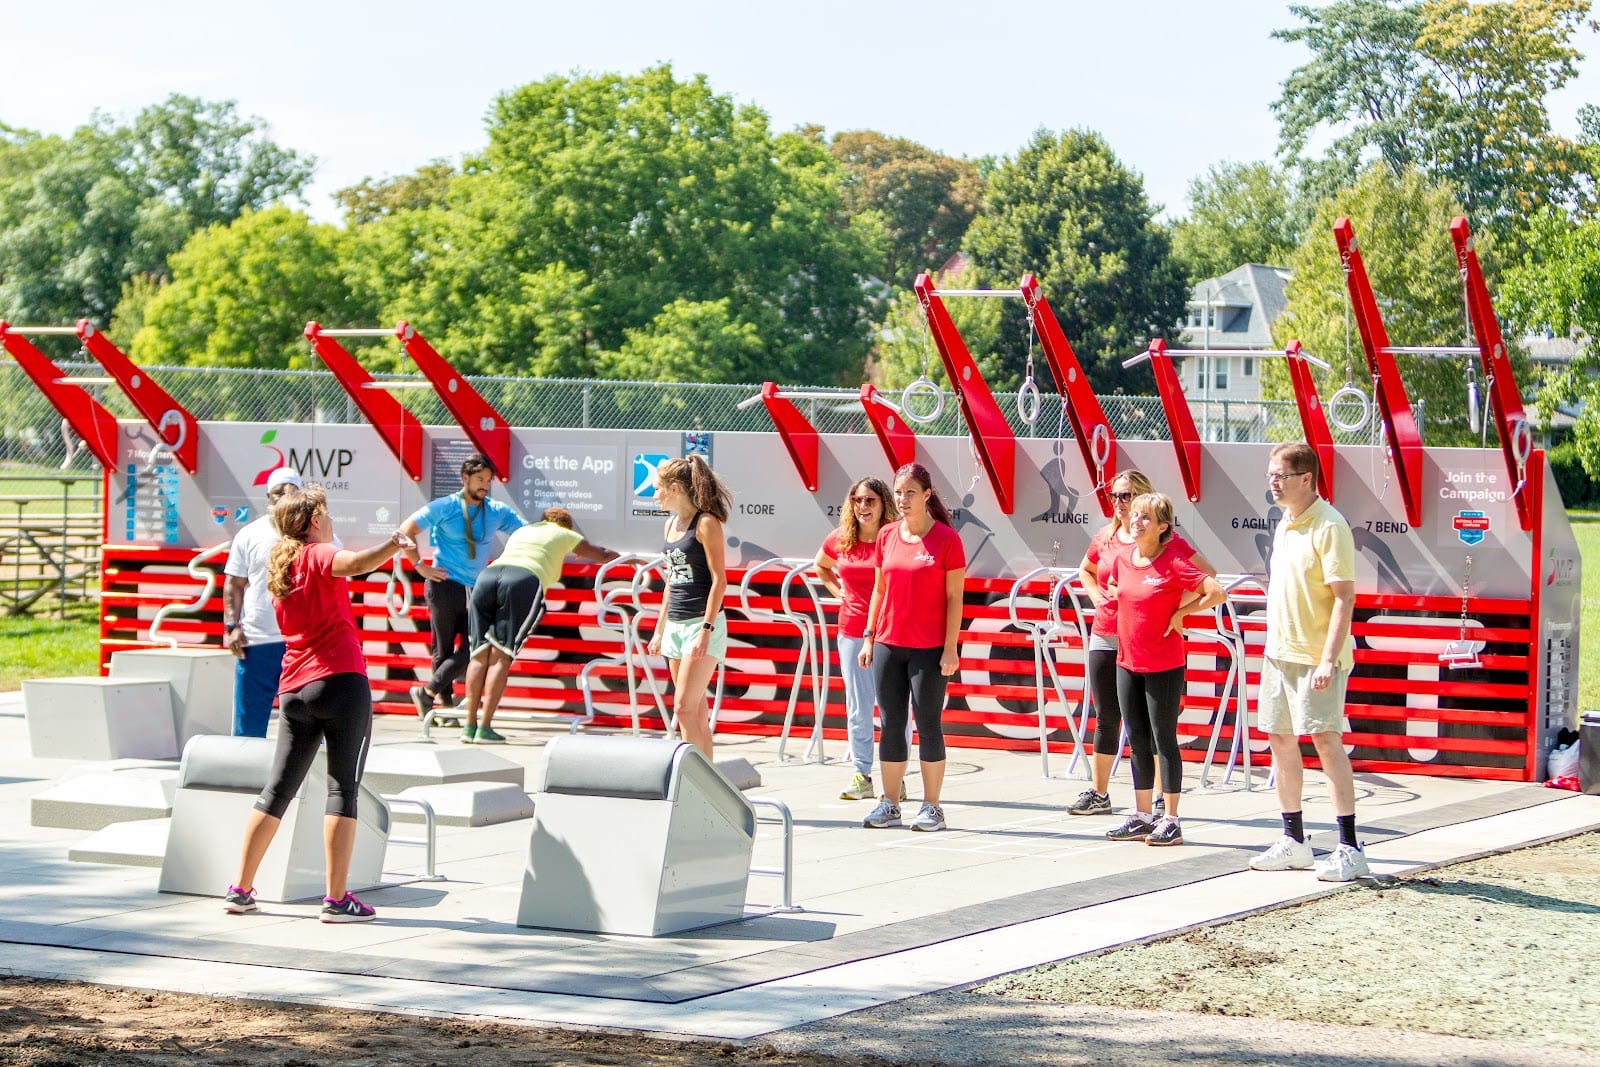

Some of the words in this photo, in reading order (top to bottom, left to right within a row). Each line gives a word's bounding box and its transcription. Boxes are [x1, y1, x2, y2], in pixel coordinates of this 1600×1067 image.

[127, 449, 133, 459] 7
[289, 448, 353, 478] MVP
[522, 454, 551, 470] Get
[553, 455, 578, 471] the
[581, 455, 615, 475] App
[534, 478, 548, 487] Get
[555, 479, 578, 488] coach
[1445, 471, 1472, 484] Join
[1475, 471, 1497, 484] the
[325, 481, 349, 491] CARE
[534, 489, 566, 498] Discover
[567, 491, 592, 499] videos
[1440, 487, 1505, 503] Campaign
[534, 501, 552, 509] Take
[566, 501, 603, 511] challenge
[739, 504, 744, 515] 1
[746, 504, 775, 515] CORE
[827, 505, 834, 516] 2
[1041, 512, 1049, 524] 4
[1052, 512, 1089, 524] LUNGE
[1231, 517, 1239, 529] 6
[1242, 518, 1280, 530] AGILIT
[1365, 521, 1373, 532] 7
[1376, 521, 1408, 534] BEND
